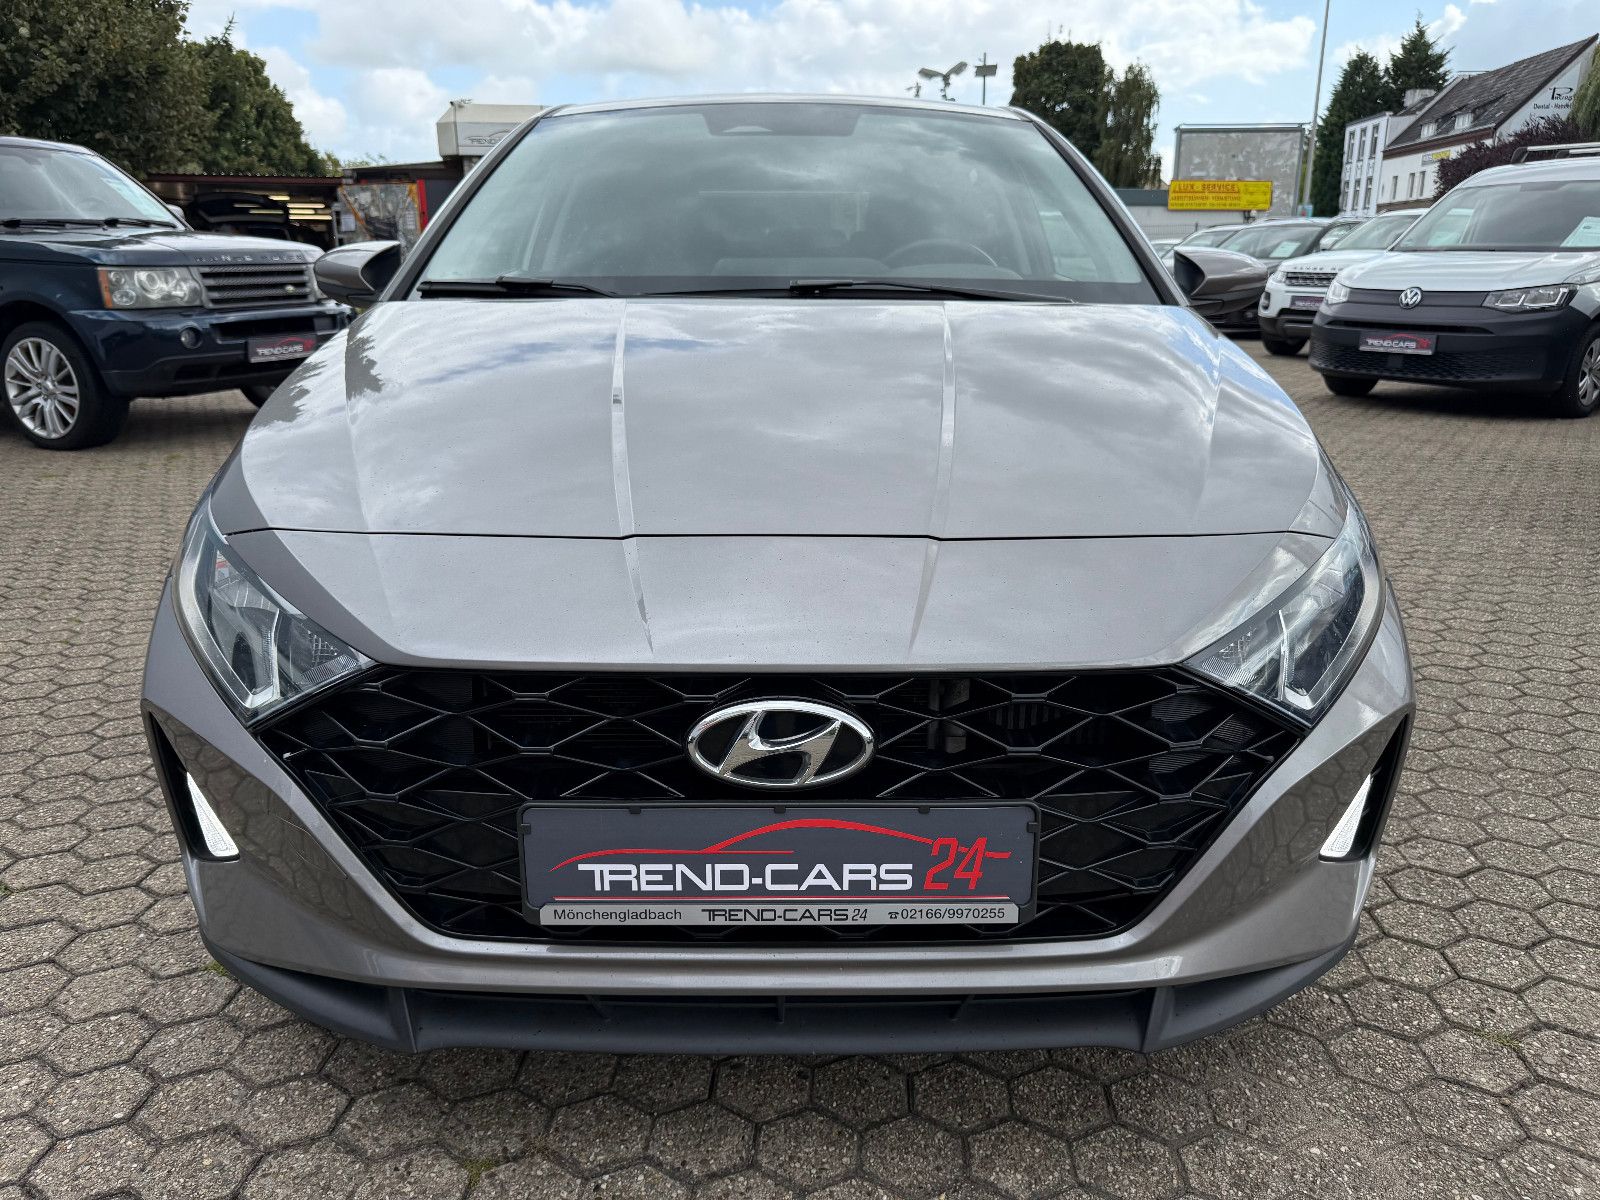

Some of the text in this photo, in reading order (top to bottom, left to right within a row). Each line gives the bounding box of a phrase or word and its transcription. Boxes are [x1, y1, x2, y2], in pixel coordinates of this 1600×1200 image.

[1201, 183, 1236, 191] SERVICE
[578, 837, 989, 892] TREND-CARS 24
[553, 908, 683, 923] Mönchengladbach
[702, 908, 849, 922] TREND-CARS
[900, 908, 1006, 922] 02166/9970255
